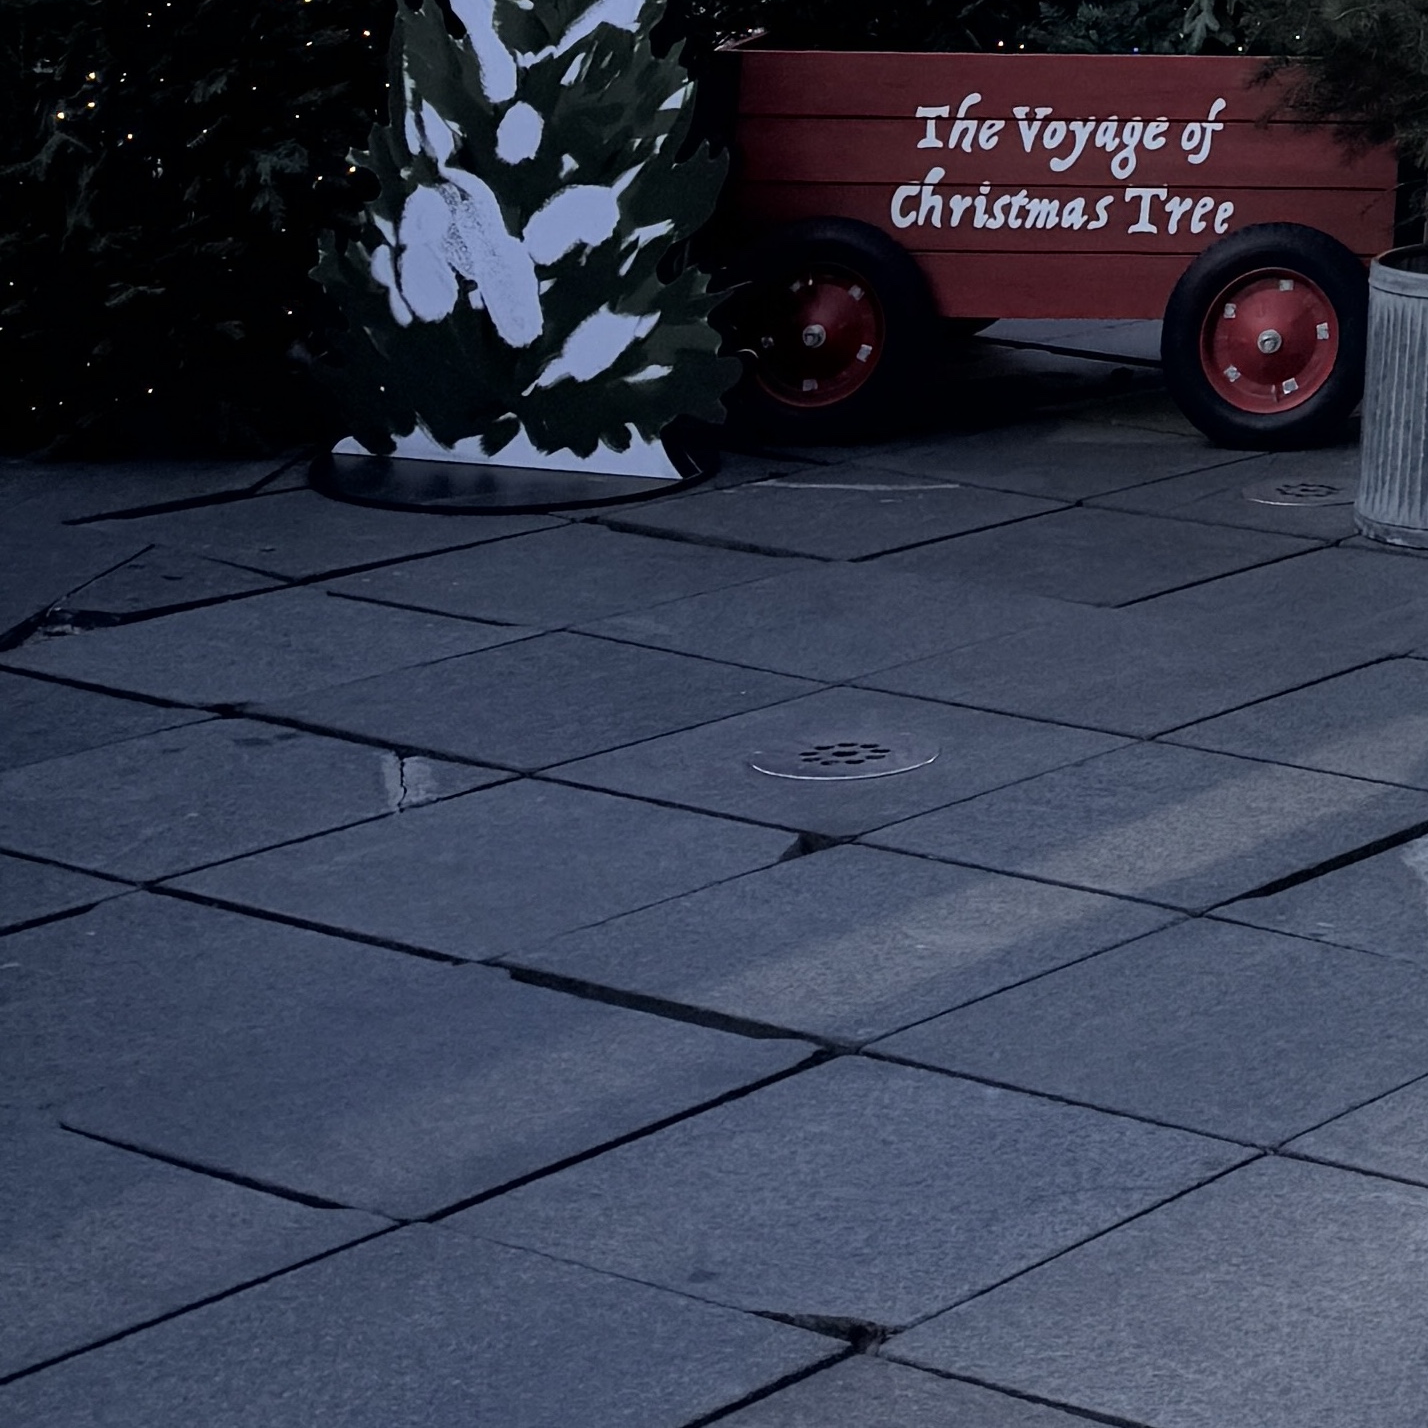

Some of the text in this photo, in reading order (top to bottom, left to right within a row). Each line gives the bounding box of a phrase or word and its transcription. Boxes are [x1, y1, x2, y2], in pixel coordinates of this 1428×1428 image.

[915, 92, 1226, 180] The Voyage of
[890, 166, 1234, 235] Christmas Tree
